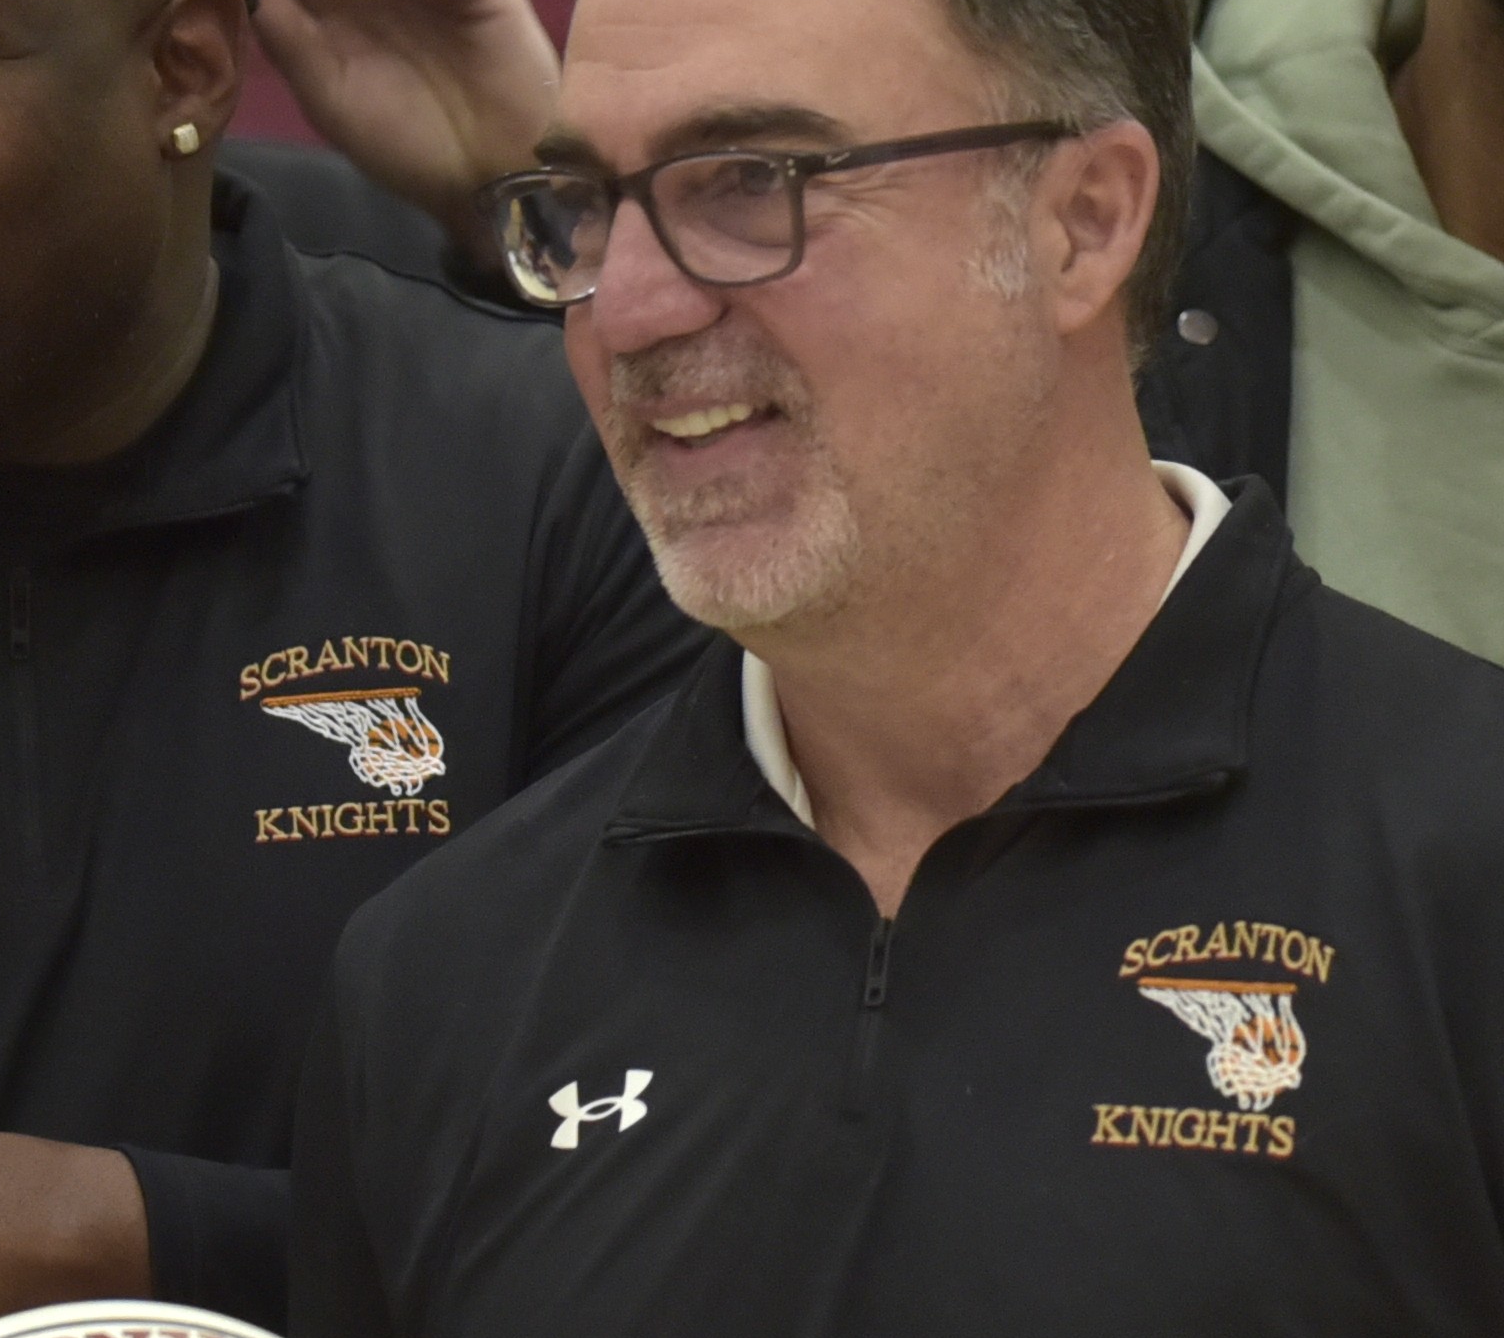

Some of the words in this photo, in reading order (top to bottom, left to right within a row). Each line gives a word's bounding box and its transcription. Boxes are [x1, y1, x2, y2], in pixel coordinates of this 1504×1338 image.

[240, 636, 451, 701] SCRANTON
[254, 799, 451, 843] KNIGHTS
[1118, 920, 1335, 984] SCRANTON
[1090, 1103, 1296, 1159] KNIGHTS
